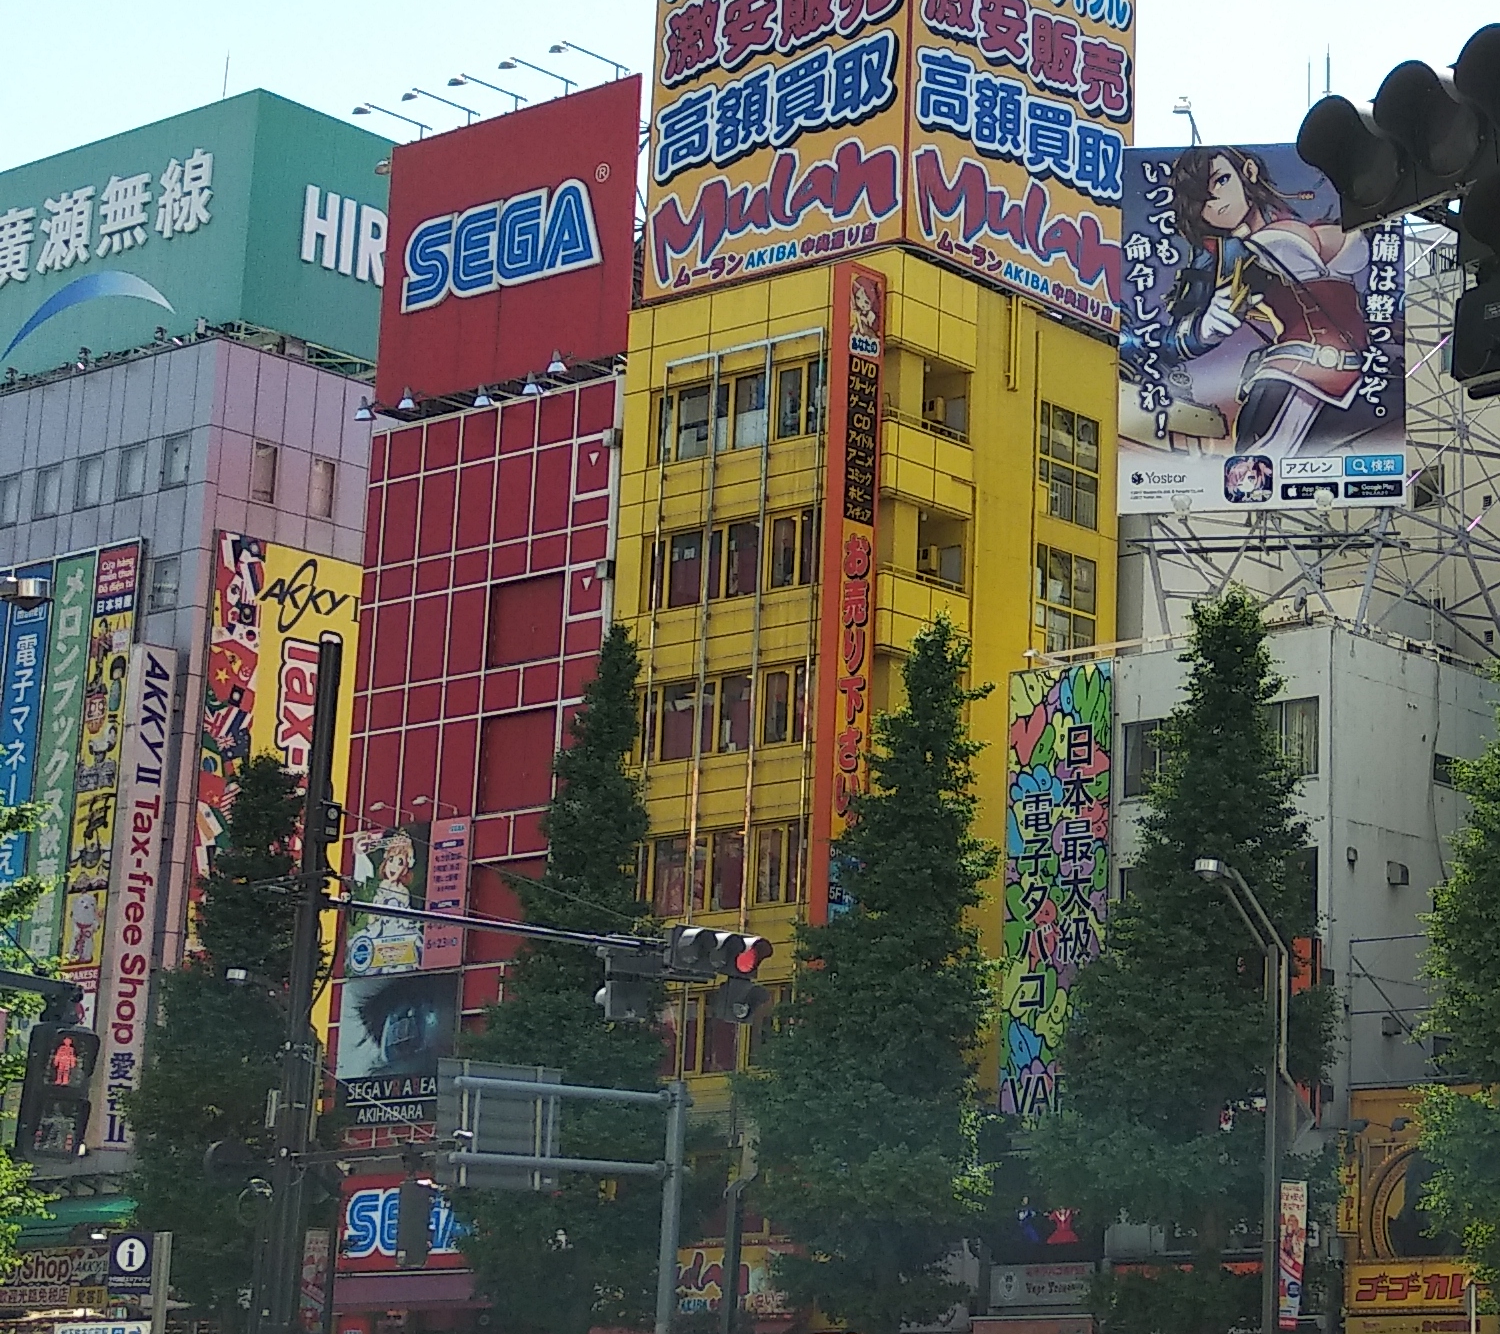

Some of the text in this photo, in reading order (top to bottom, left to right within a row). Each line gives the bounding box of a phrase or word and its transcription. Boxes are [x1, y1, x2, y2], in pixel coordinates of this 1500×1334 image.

[655, 33, 896, 180] 高額買取
[916, 49, 1124, 201] 高額買取
[0, 148, 215, 285] 廣瀬無線
[651, 140, 900, 288] Mulan
[913, 145, 1120, 307] Mulan
[1142, 162, 1178, 264] いつでも
[402, 178, 603, 314] SEGA
[745, 243, 798, 271] AKIBA
[802, 224, 877, 257] 中央通り店
[1004, 262, 1049, 294] AKIBA
[850, 376, 876, 396] ブルーレイ
[852, 358, 876, 378] DVD
[850, 394, 875, 415] ゲーム
[853, 414, 871, 430] CD
[848, 448, 874, 467] アニメ
[849, 430, 874, 449] アイドル
[848, 468, 872, 486] コミック
[1146, 471, 1188, 485] Yostar
[1286, 461, 1332, 474] アズレン
[849, 486, 871, 502] ホビー
[139, 651, 170, 762] AKKY
[1056, 724, 1094, 962] 日本最大級
[121, 794, 160, 946] Tax-free
[1017, 792, 1052, 1008] 電子タバコ
[111, 952, 147, 1045] Shop
[347, 1080, 381, 1101] SEGA
[357, 1104, 424, 1124] AKIHABARA
[345, 1187, 468, 1259] SEA
[22, 1251, 69, 1282] Shop
